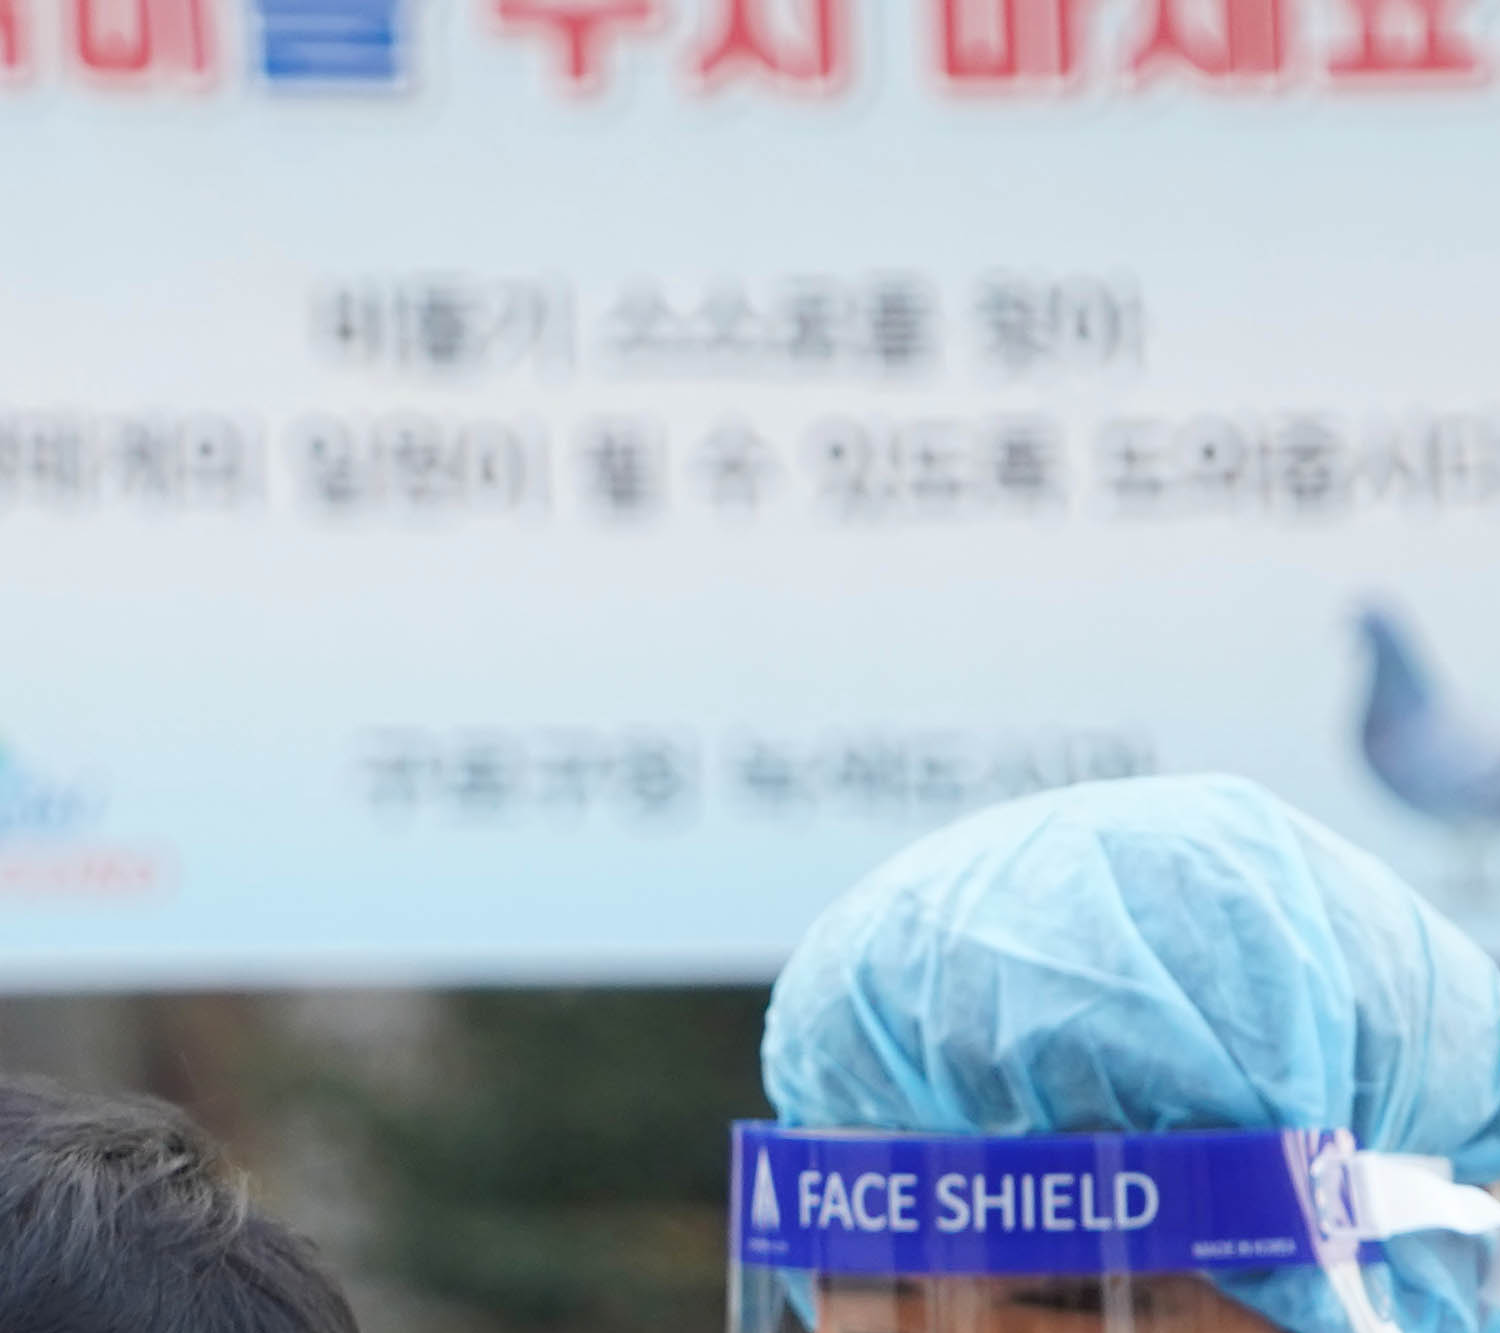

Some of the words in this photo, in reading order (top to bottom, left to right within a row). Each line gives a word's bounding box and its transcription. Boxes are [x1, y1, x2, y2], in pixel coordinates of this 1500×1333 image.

[312, 278, 570, 372] 비둘기
[688, 423, 780, 520] 수
[798, 1170, 921, 1232] FACE
[934, 1172, 1160, 1233] SHIELD
